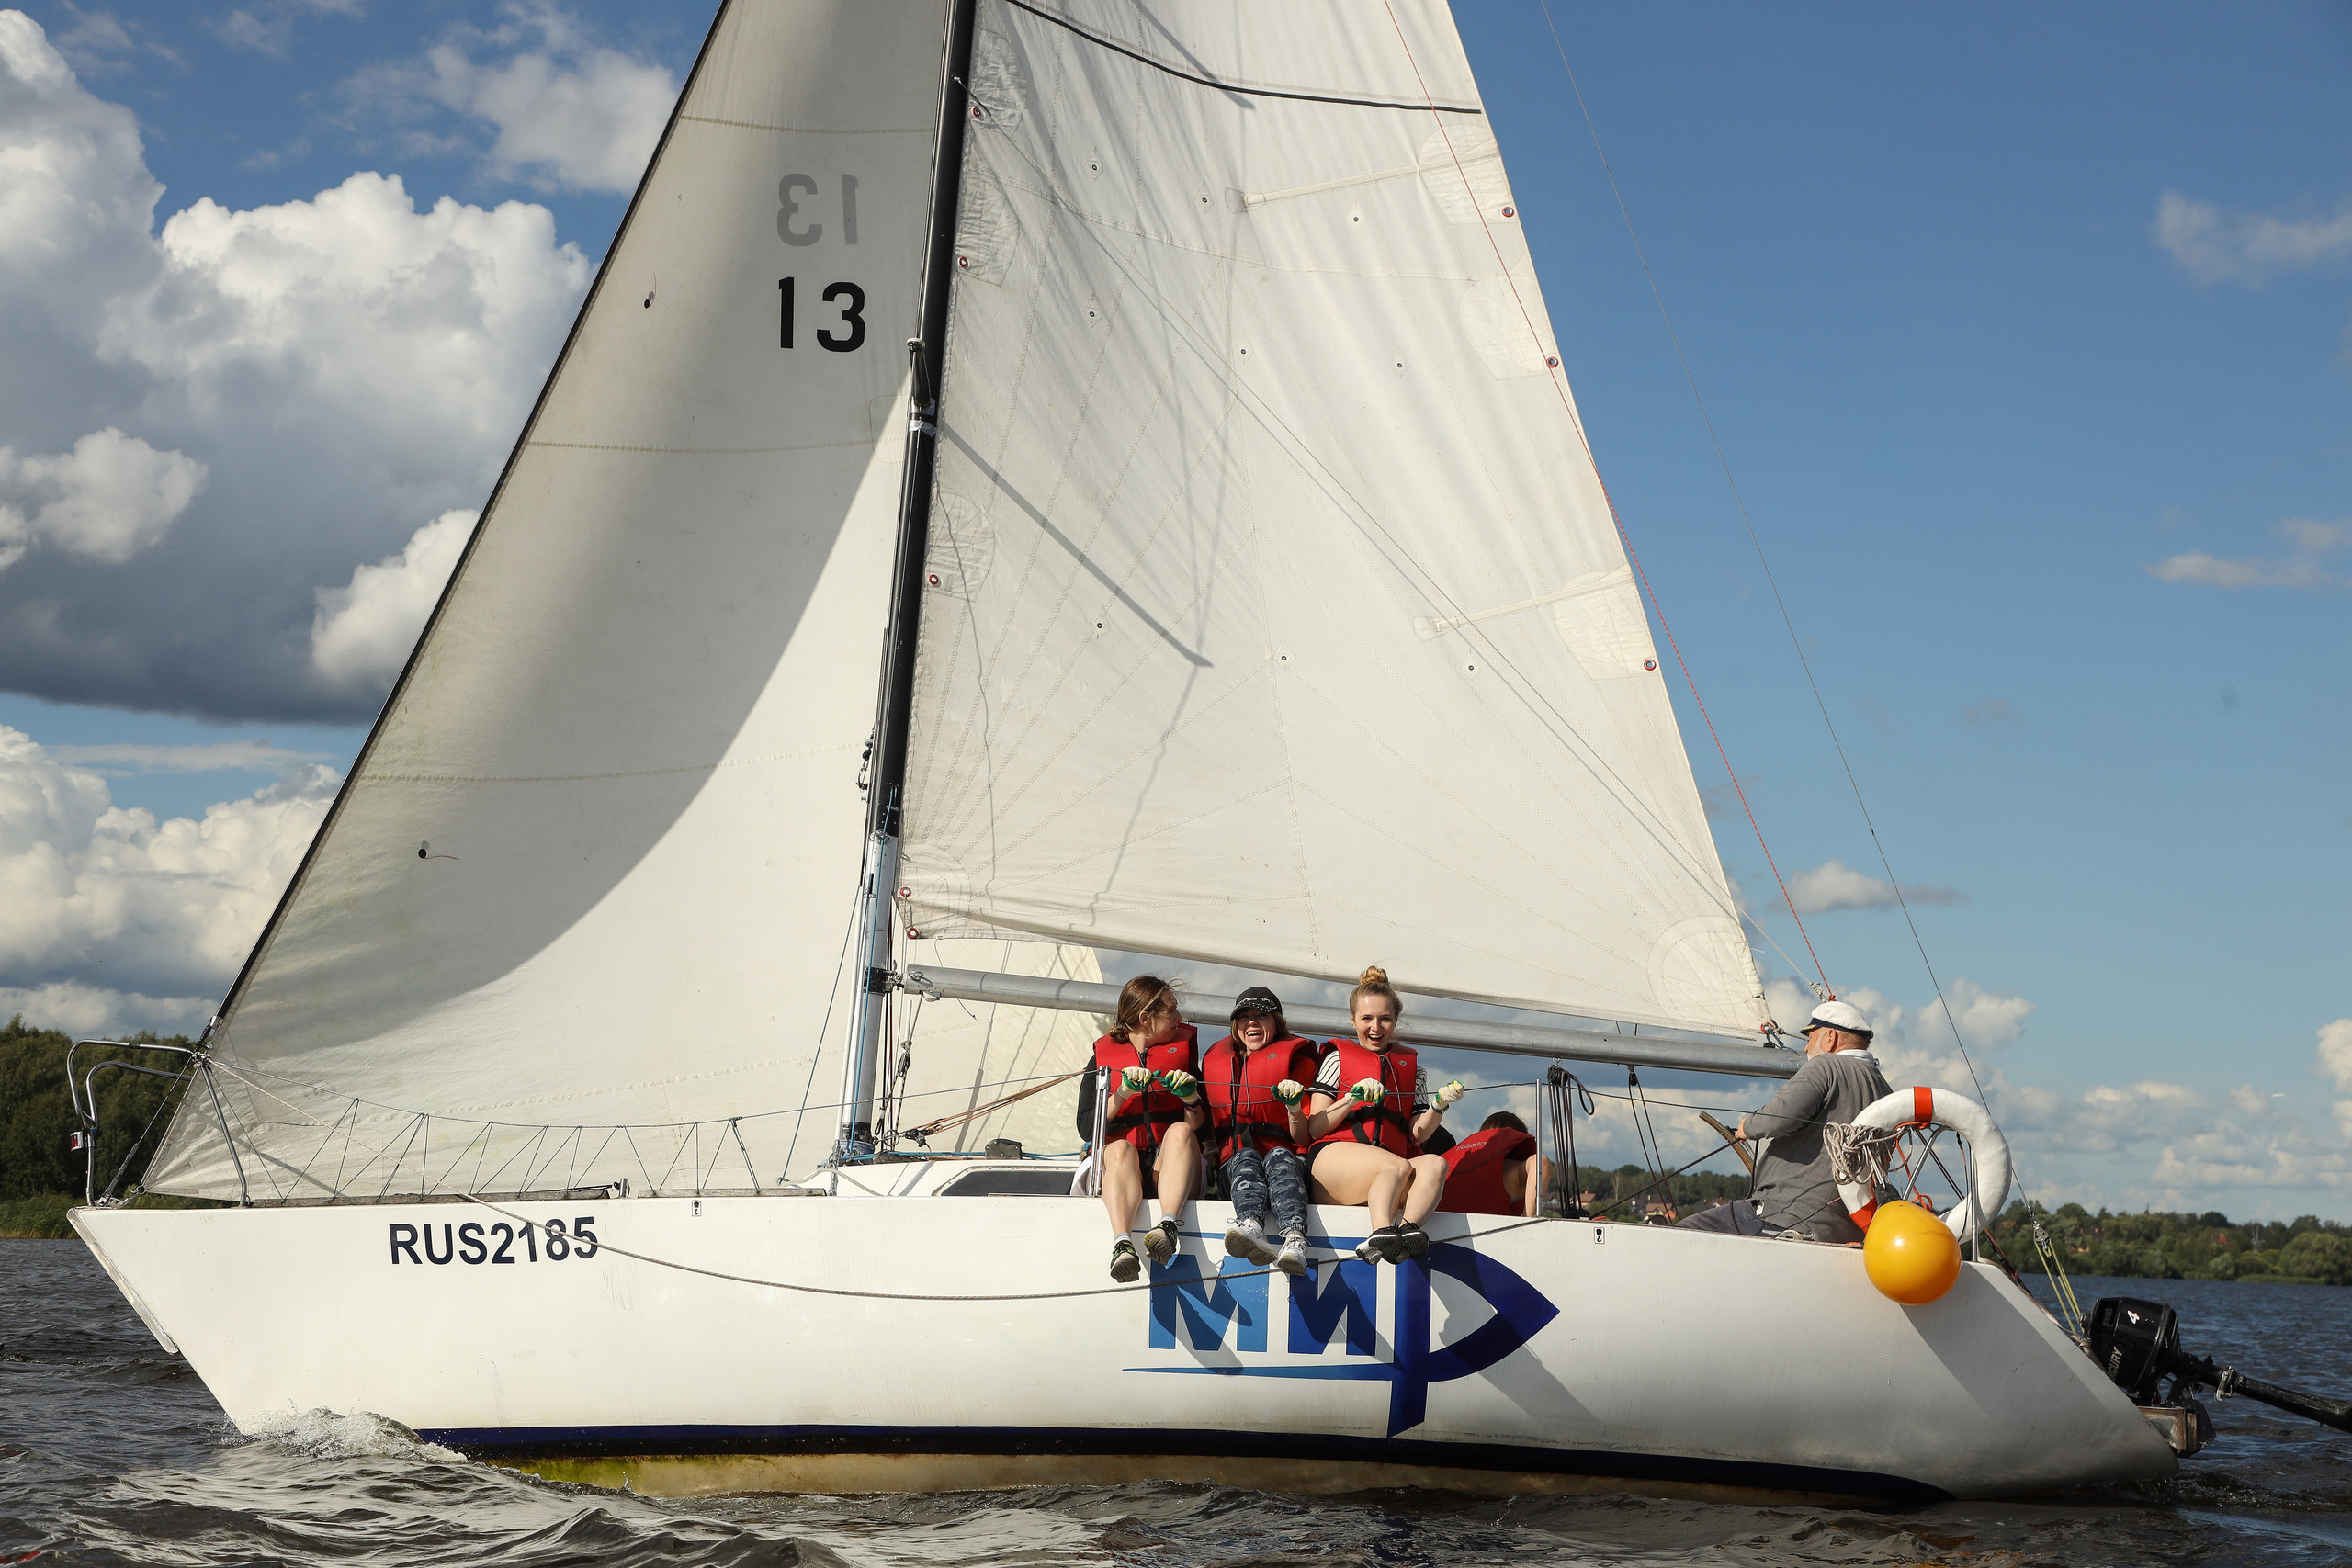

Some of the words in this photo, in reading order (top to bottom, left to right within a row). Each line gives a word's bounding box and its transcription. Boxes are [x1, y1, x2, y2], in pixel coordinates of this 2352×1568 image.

[778, 276, 865, 353] 13
[389, 1216, 598, 1265] RUS2185
[2127, 1310, 2140, 1324] 4
